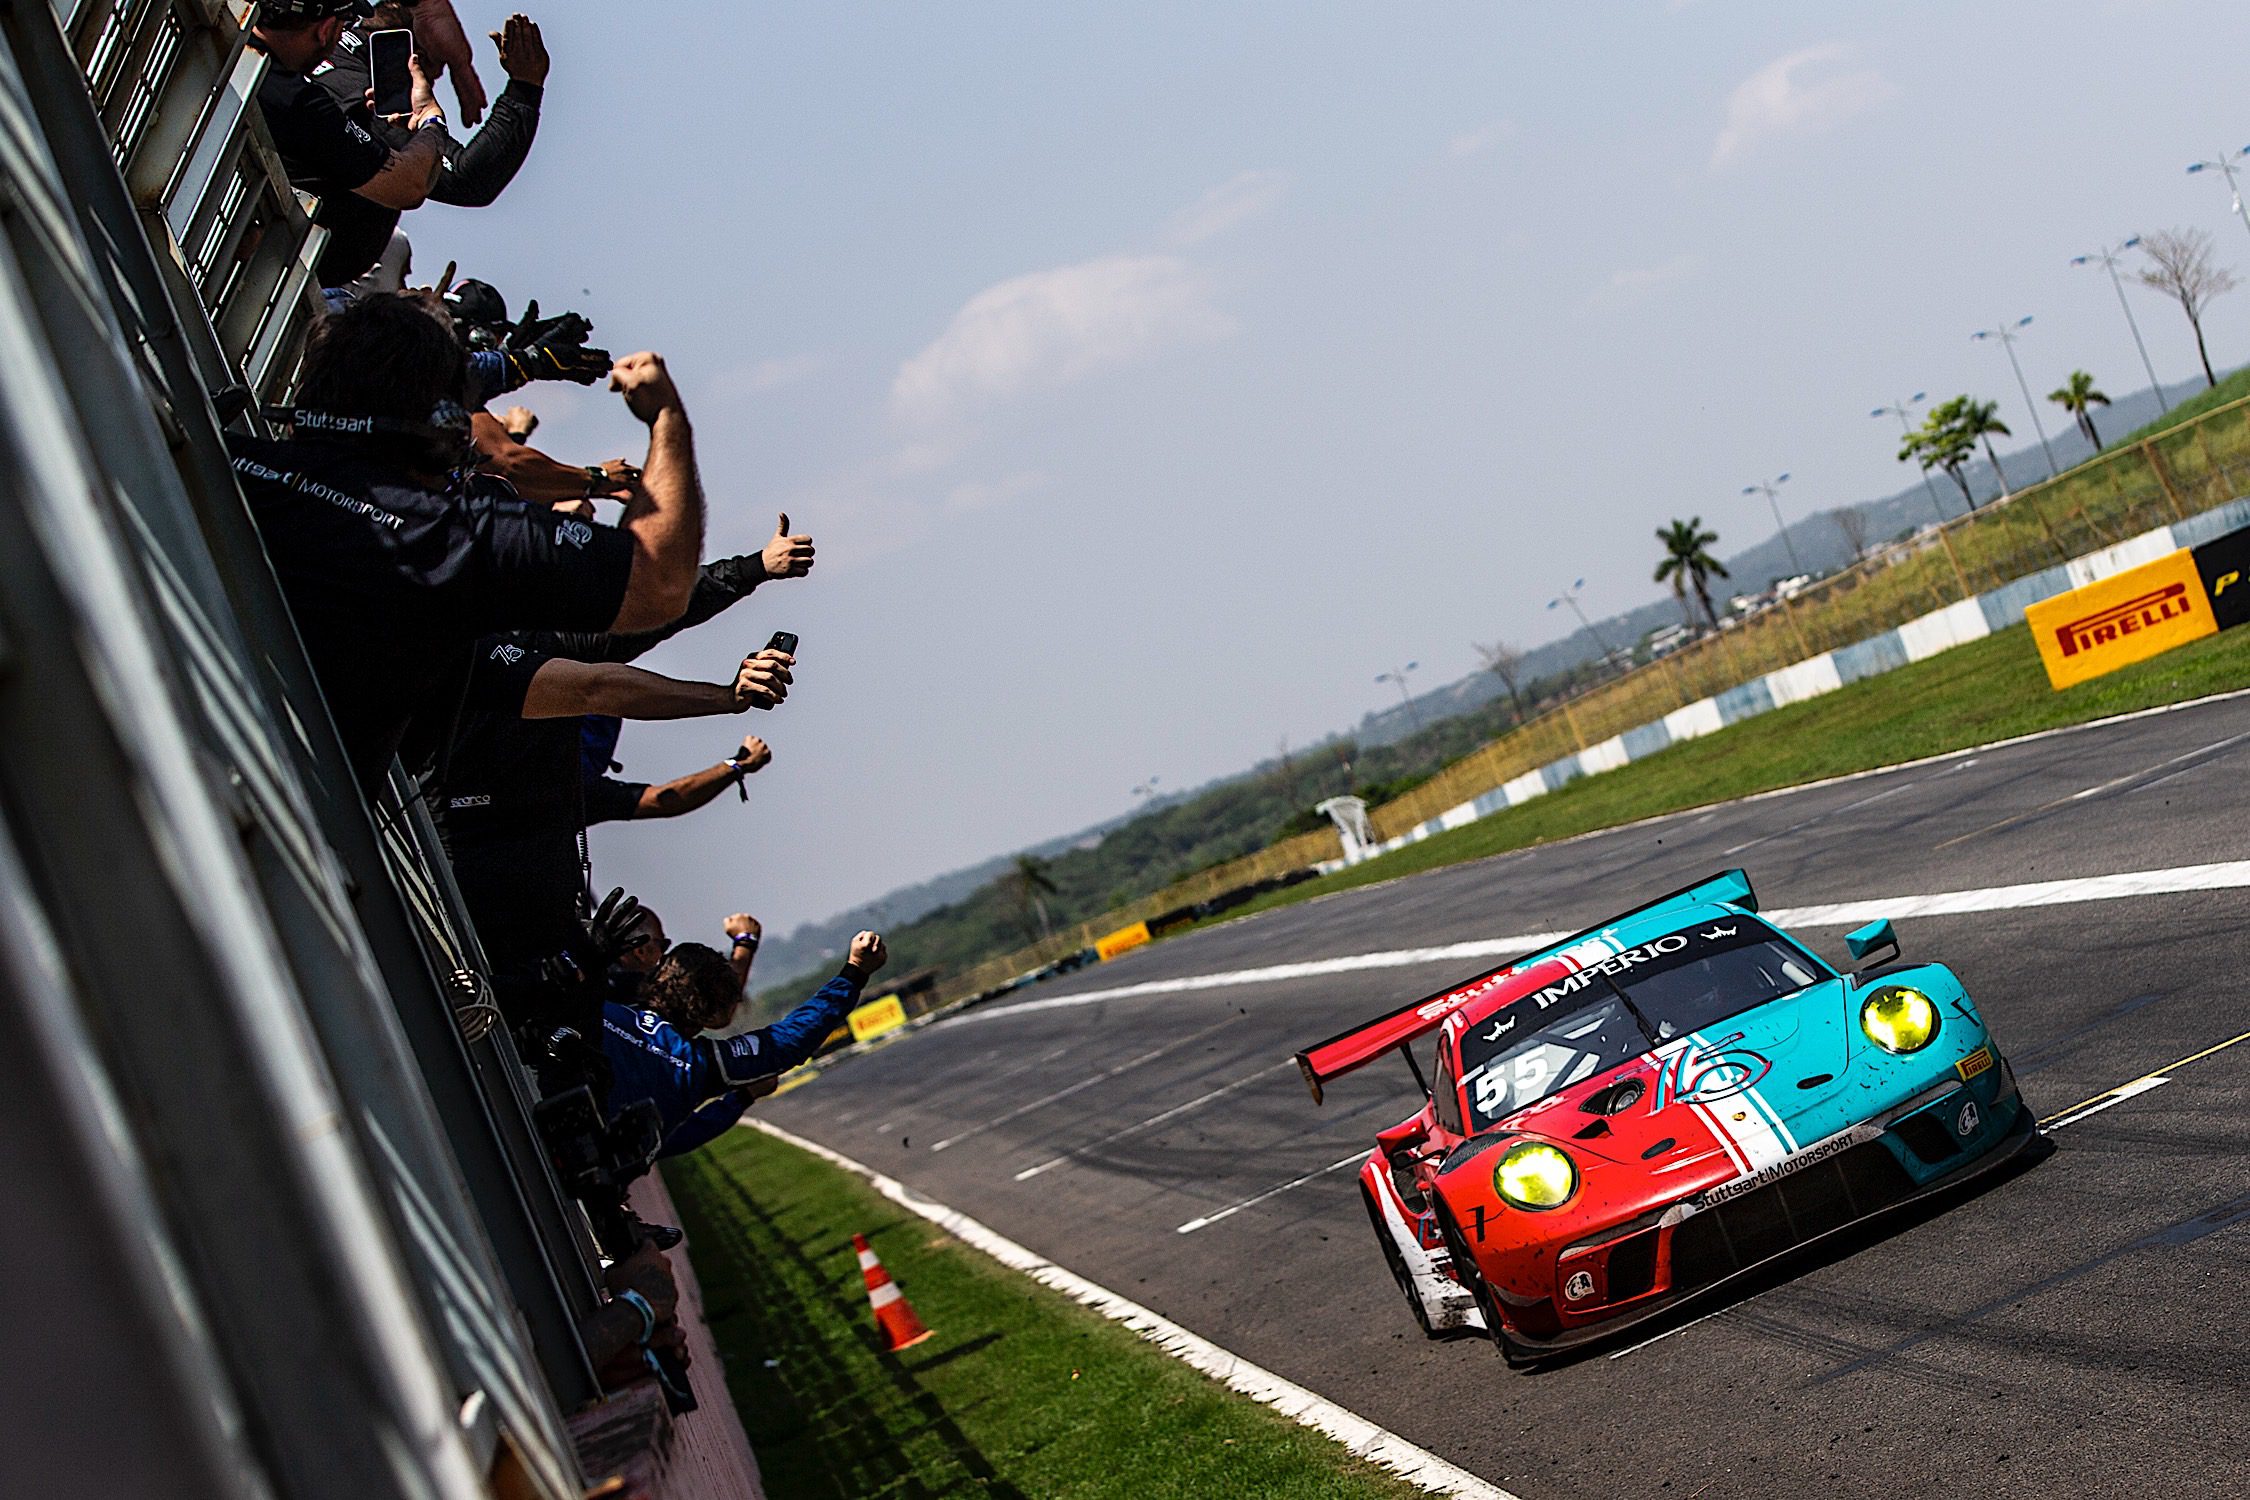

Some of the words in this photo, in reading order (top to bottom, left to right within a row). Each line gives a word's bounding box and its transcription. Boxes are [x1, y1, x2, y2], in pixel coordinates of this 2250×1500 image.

[294, 409, 374, 434] Stuttgart
[231, 457, 294, 484] ttgart
[297, 477, 405, 531] MOTORSPORT
[2055, 582, 2191, 658] PIRELLI
[1476, 1044, 1549, 1113] 55
[1959, 1050, 1992, 1078] PIRELLI
